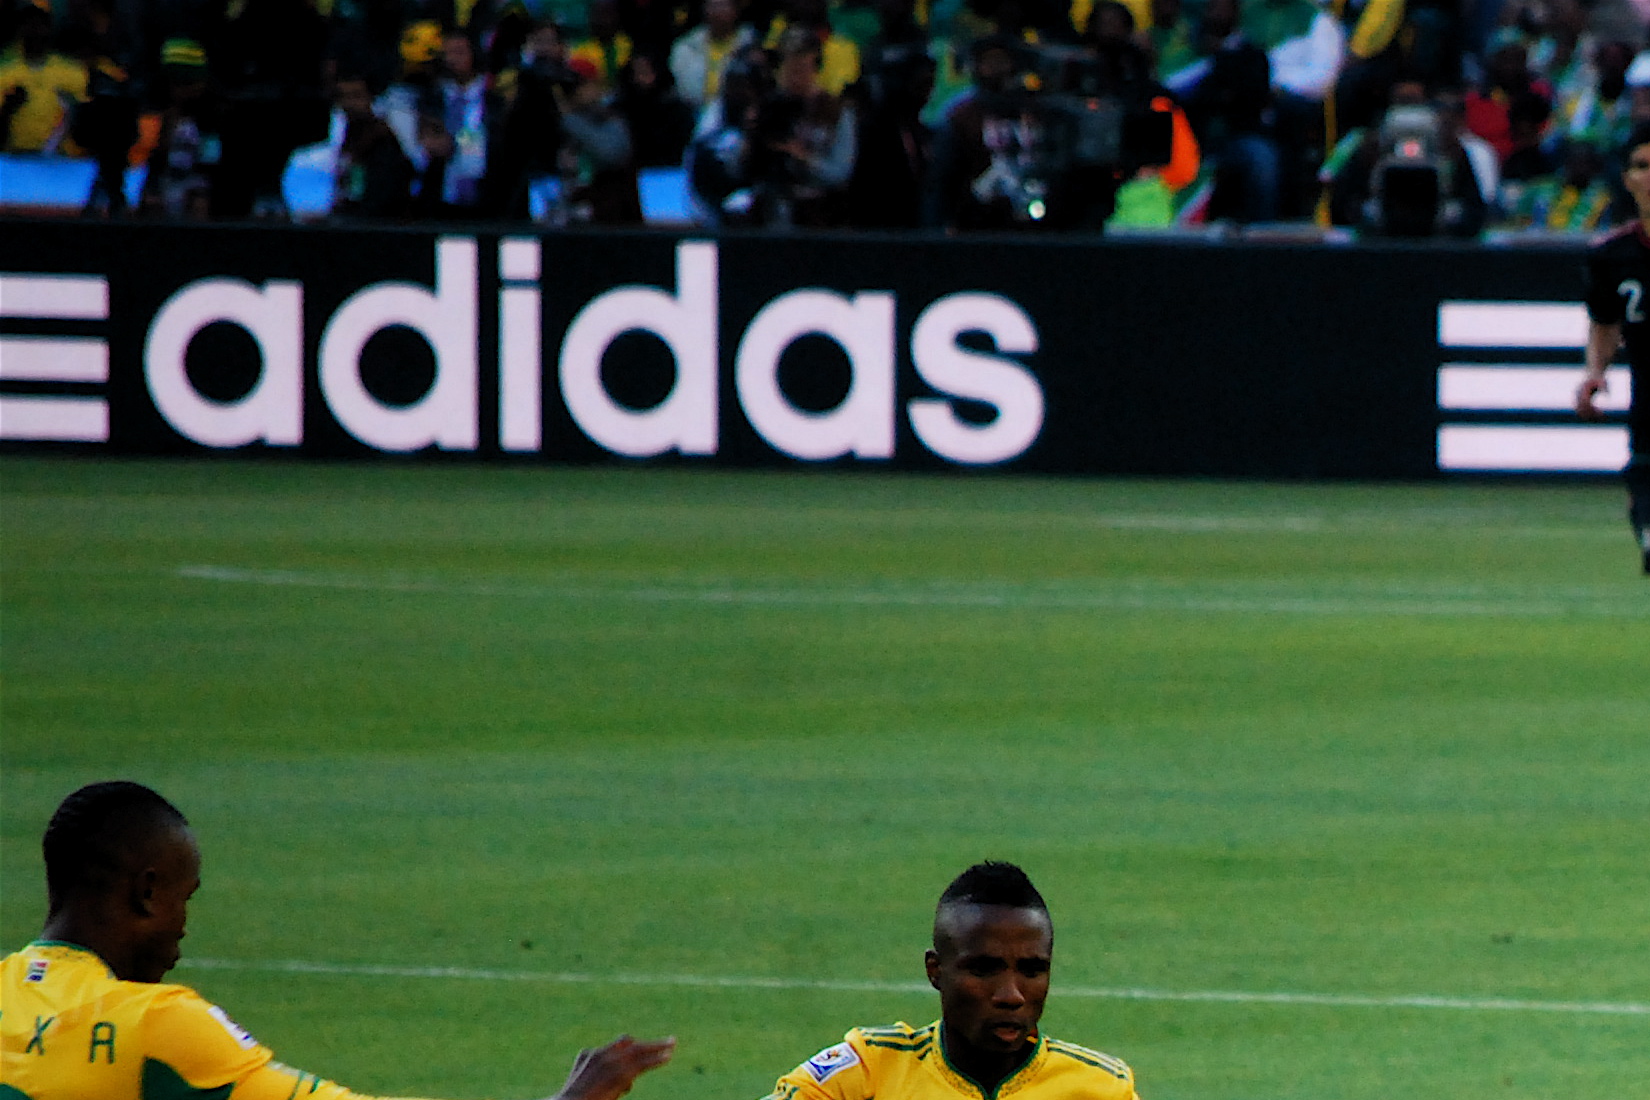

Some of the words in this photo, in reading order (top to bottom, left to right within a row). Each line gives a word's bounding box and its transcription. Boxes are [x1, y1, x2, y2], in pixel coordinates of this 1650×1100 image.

[1617, 278, 1645, 323] 2
[143, 237, 1045, 464] adidas
[0, 1011, 116, 1064] XA
